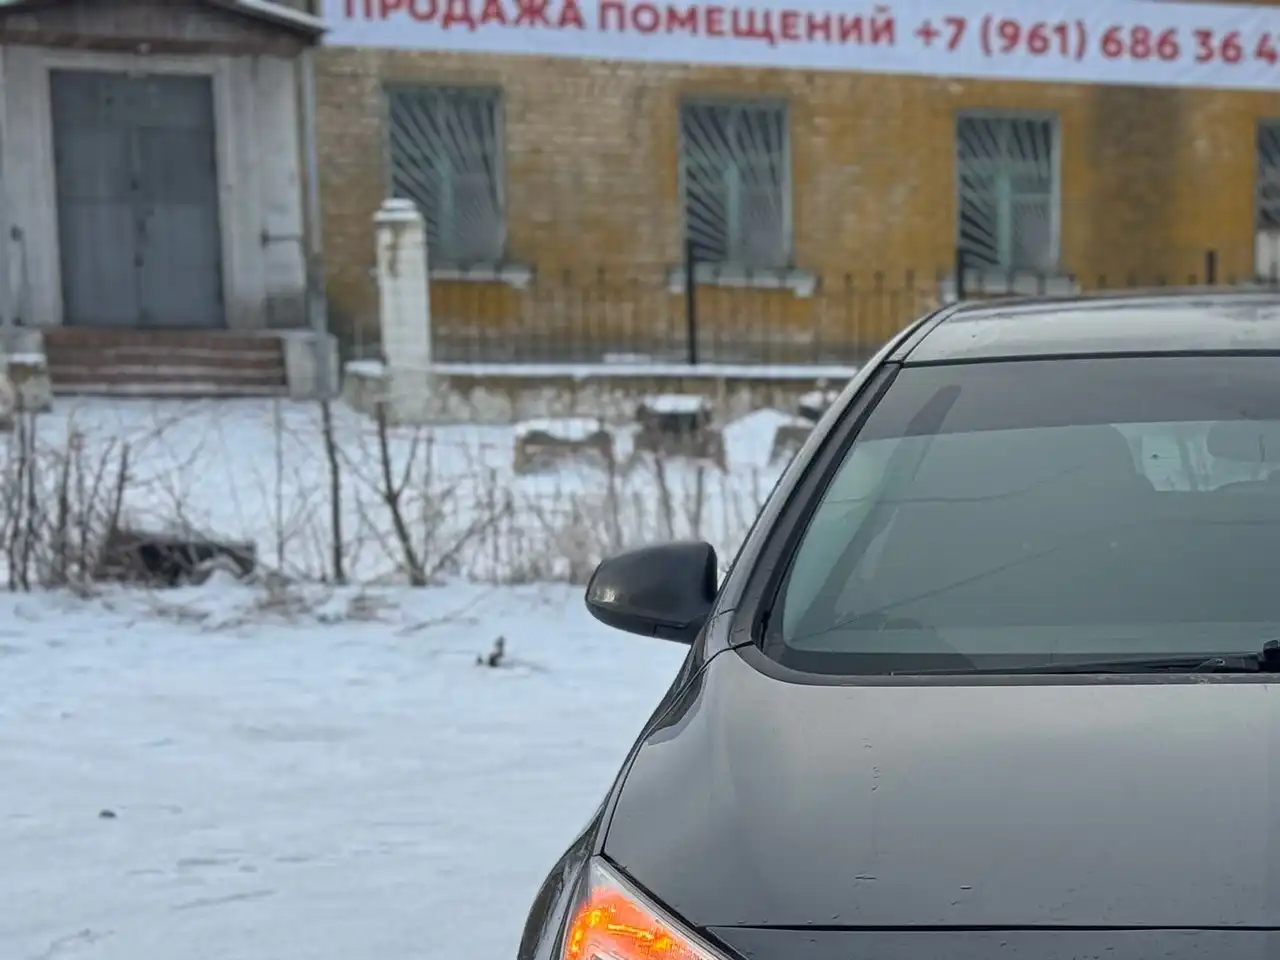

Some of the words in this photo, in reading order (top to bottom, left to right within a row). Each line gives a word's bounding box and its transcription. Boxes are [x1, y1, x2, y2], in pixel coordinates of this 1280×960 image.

[344, 0, 585, 32] ПРОДАЖА
[599, 2, 896, 45] ПОМЕЩЕНИЙ
[914, 17, 967, 49] +7
[980, 16, 1087, 60] (961)
[1101, 25, 1180, 61] 686
[1194, 29, 1243, 63] 36
